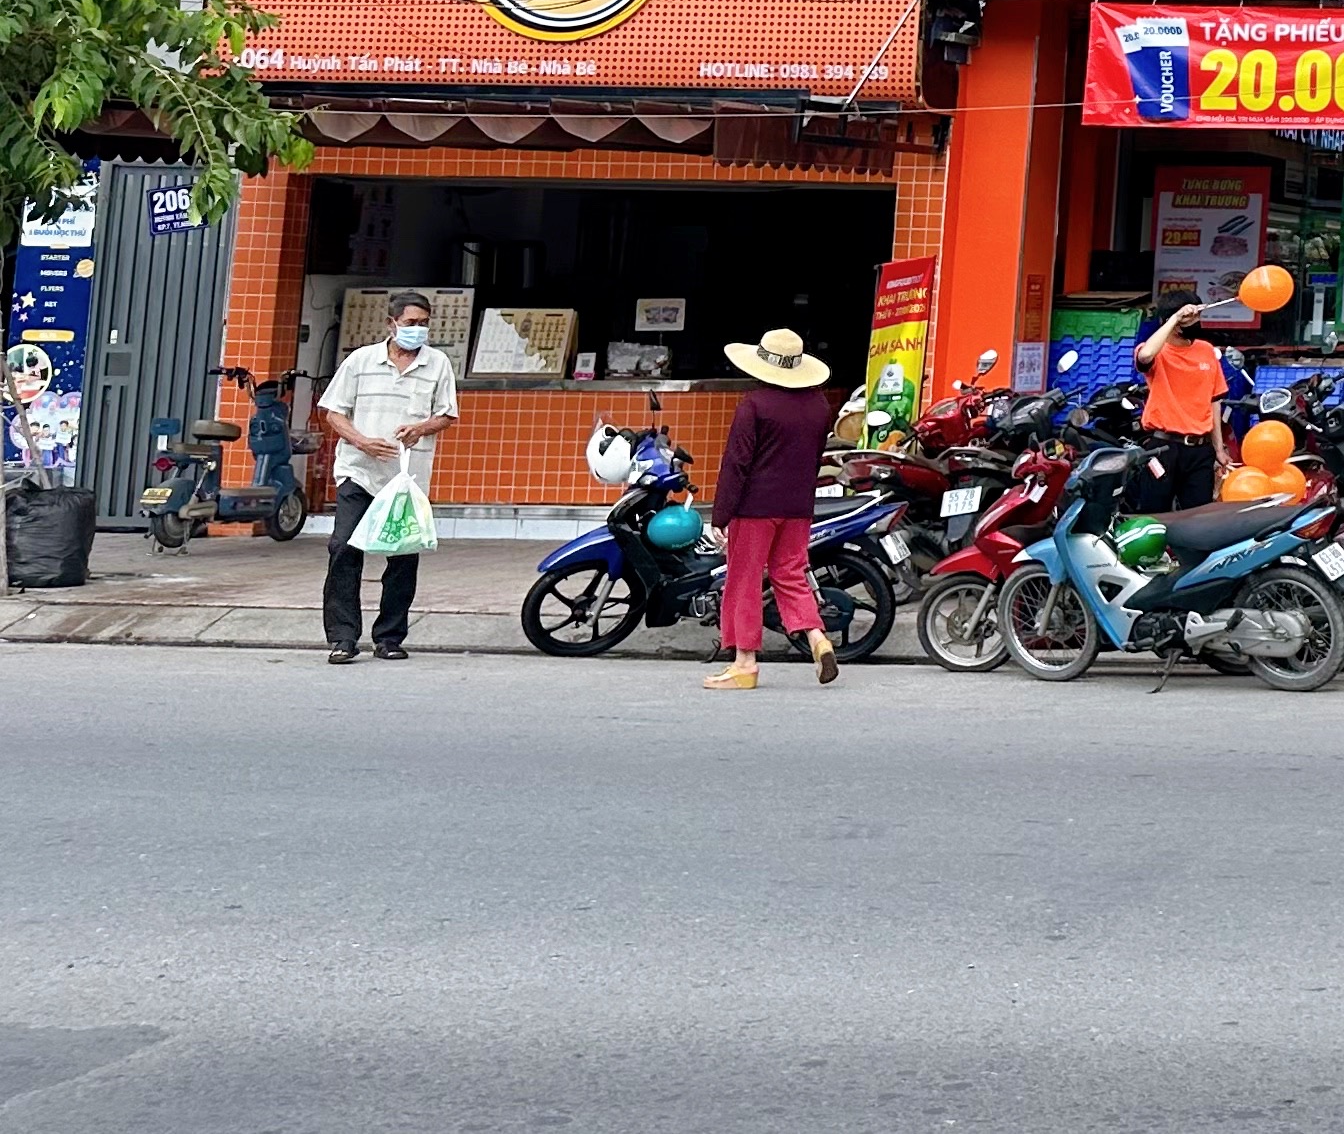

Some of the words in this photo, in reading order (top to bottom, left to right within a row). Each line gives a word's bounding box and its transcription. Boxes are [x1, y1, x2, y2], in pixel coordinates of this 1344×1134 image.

[1200, 17, 1268, 46] TẶNG
[233, 48, 285, 70] 064
[348, 52, 379, 72] Tấn
[384, 55, 422, 73] Phát
[471, 58, 503, 75] Nhà
[507, 59, 529, 75] Bè
[540, 59, 572, 76] Nhà
[576, 60, 598, 76] Bè
[699, 62, 776, 79] HOTLINE:
[780, 63, 819, 79] 0981
[823, 65, 854, 80] 394
[1159, 50, 1175, 114] VOUCHER
[152, 187, 191, 215] 206
